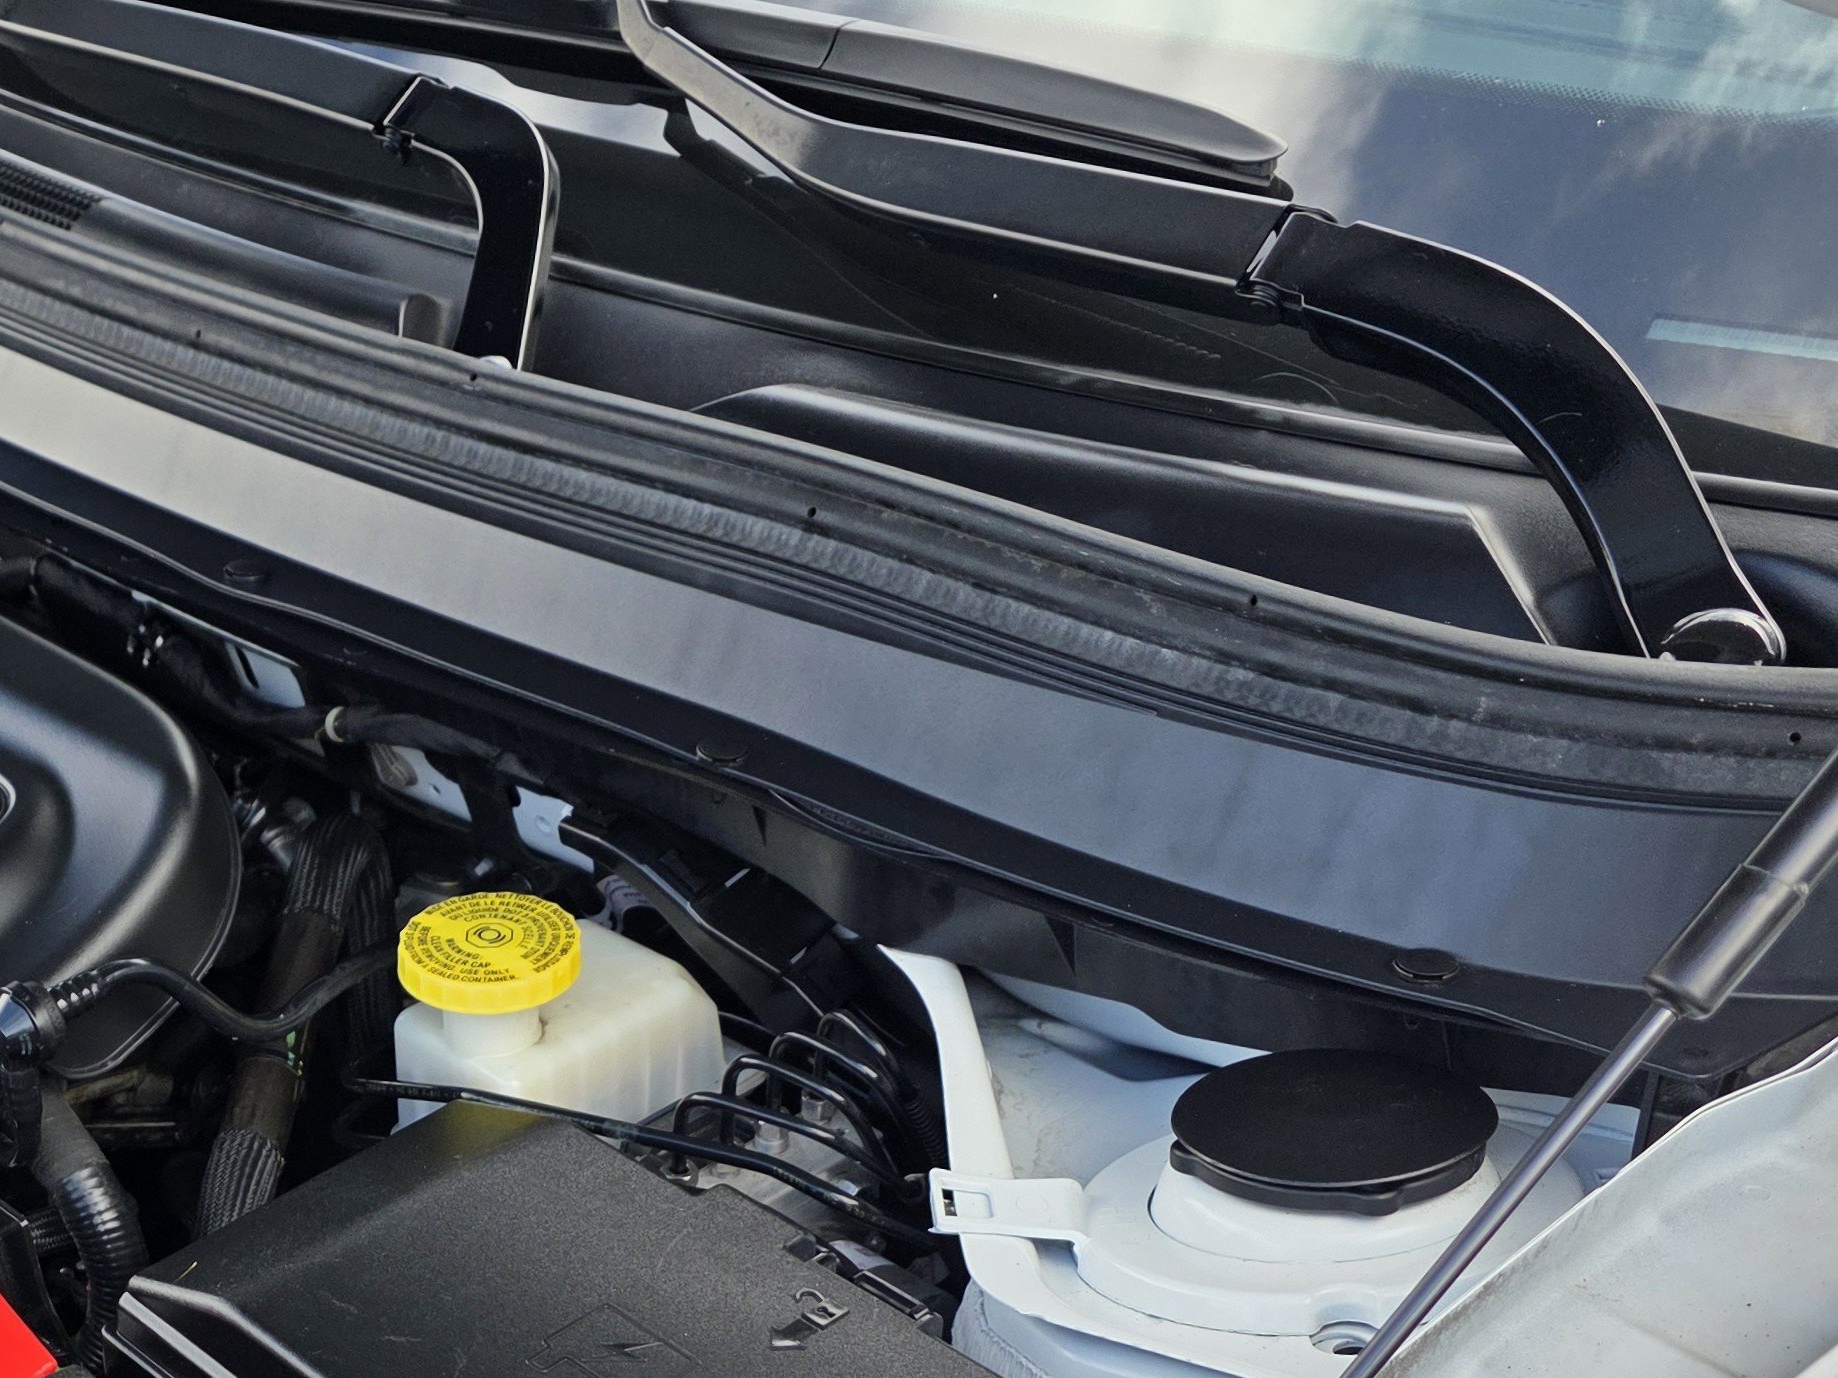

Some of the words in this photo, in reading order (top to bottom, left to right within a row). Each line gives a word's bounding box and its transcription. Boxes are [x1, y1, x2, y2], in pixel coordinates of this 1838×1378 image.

[495, 892, 542, 905] NETTOYER
[440, 950, 469, 966] FILLER
[427, 966, 460, 981] SEALED
[483, 968, 510, 976] ONLY
